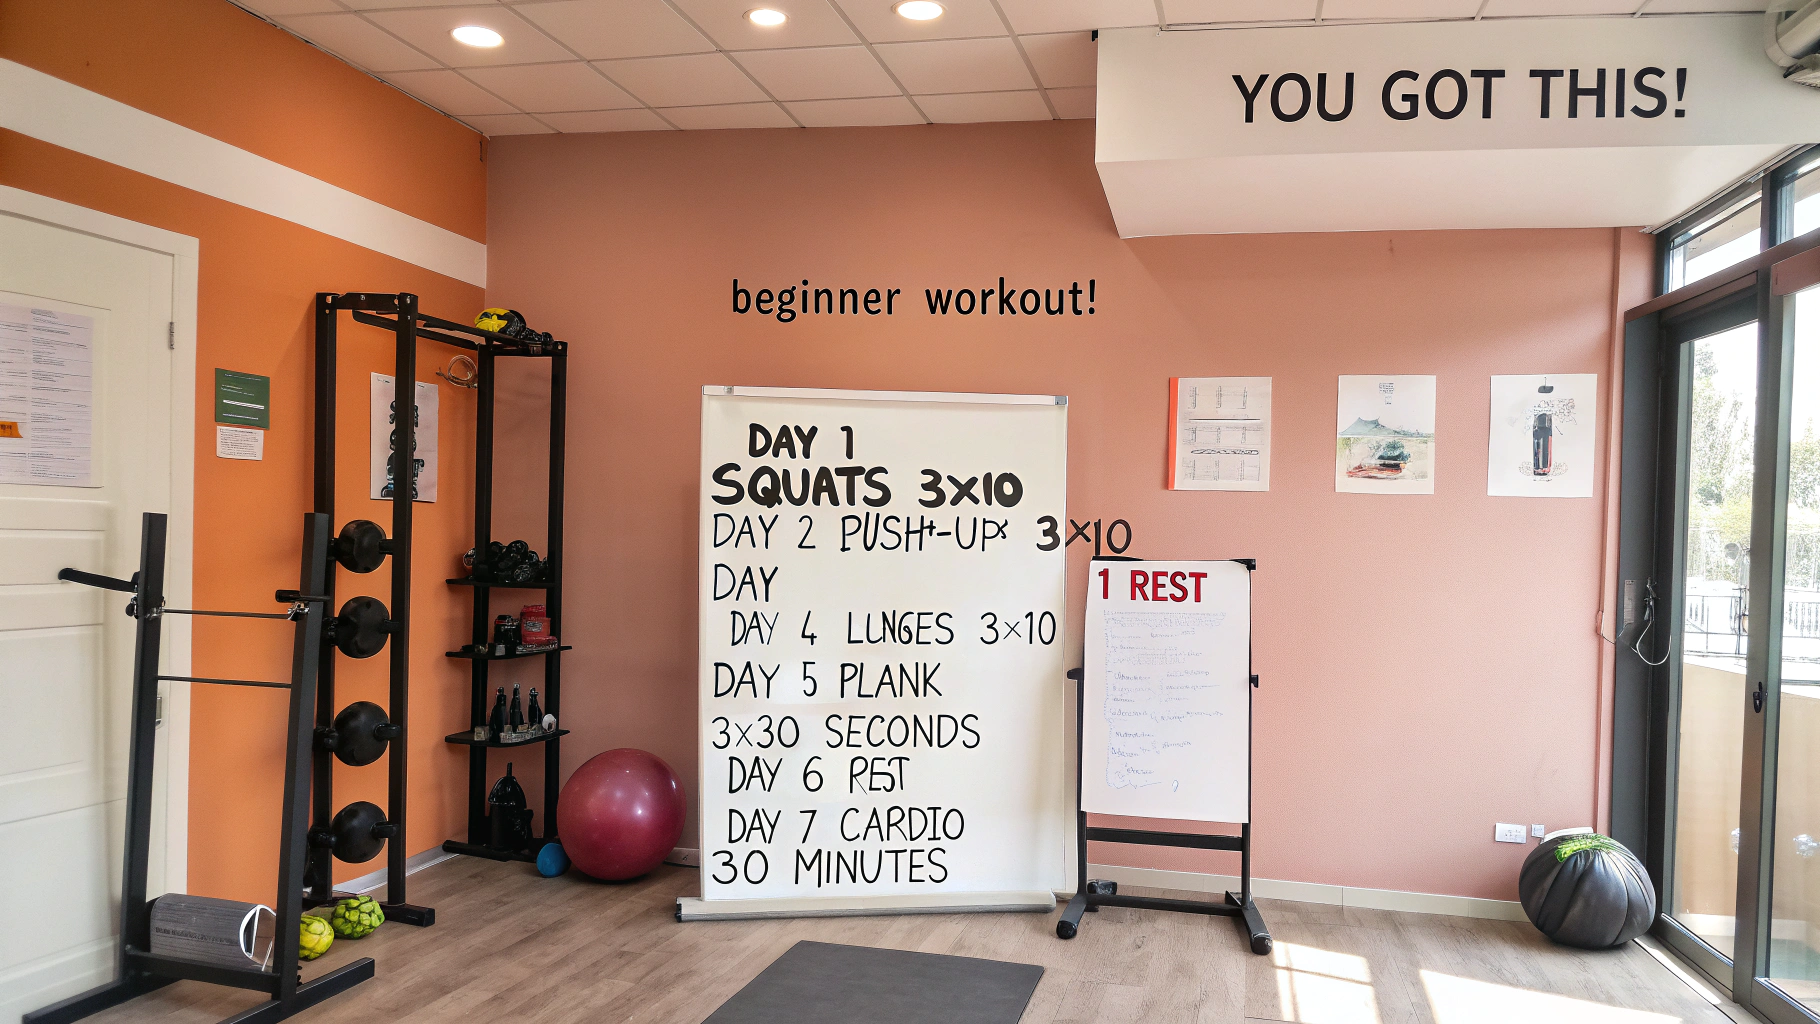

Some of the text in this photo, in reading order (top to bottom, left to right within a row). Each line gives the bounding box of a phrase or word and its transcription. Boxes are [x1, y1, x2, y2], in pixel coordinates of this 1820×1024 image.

[1231, 66, 1688, 124] YOU GOT THIS!
[732, 276, 1096, 324] beginner workout!
[748, 422, 854, 460] DAY 1
[711, 462, 892, 509] SQUATS
[713, 512, 779, 550] DAY
[797, 514, 816, 549] 2
[713, 563, 779, 603] DAY
[1098, 568, 1208, 603] 1 REST
[730, 610, 779, 647] DAY
[801, 610, 818, 646] 4
[847, 609, 955, 645] LUNGES
[713, 660, 943, 699] DAY 5 PLANK
[825, 713, 981, 749] SECONDS
[728, 755, 911, 794] DAY 6 REST
[728, 805, 965, 845] DAY 7 CARDIO
[712, 847, 948, 888] 30 MINUTES
